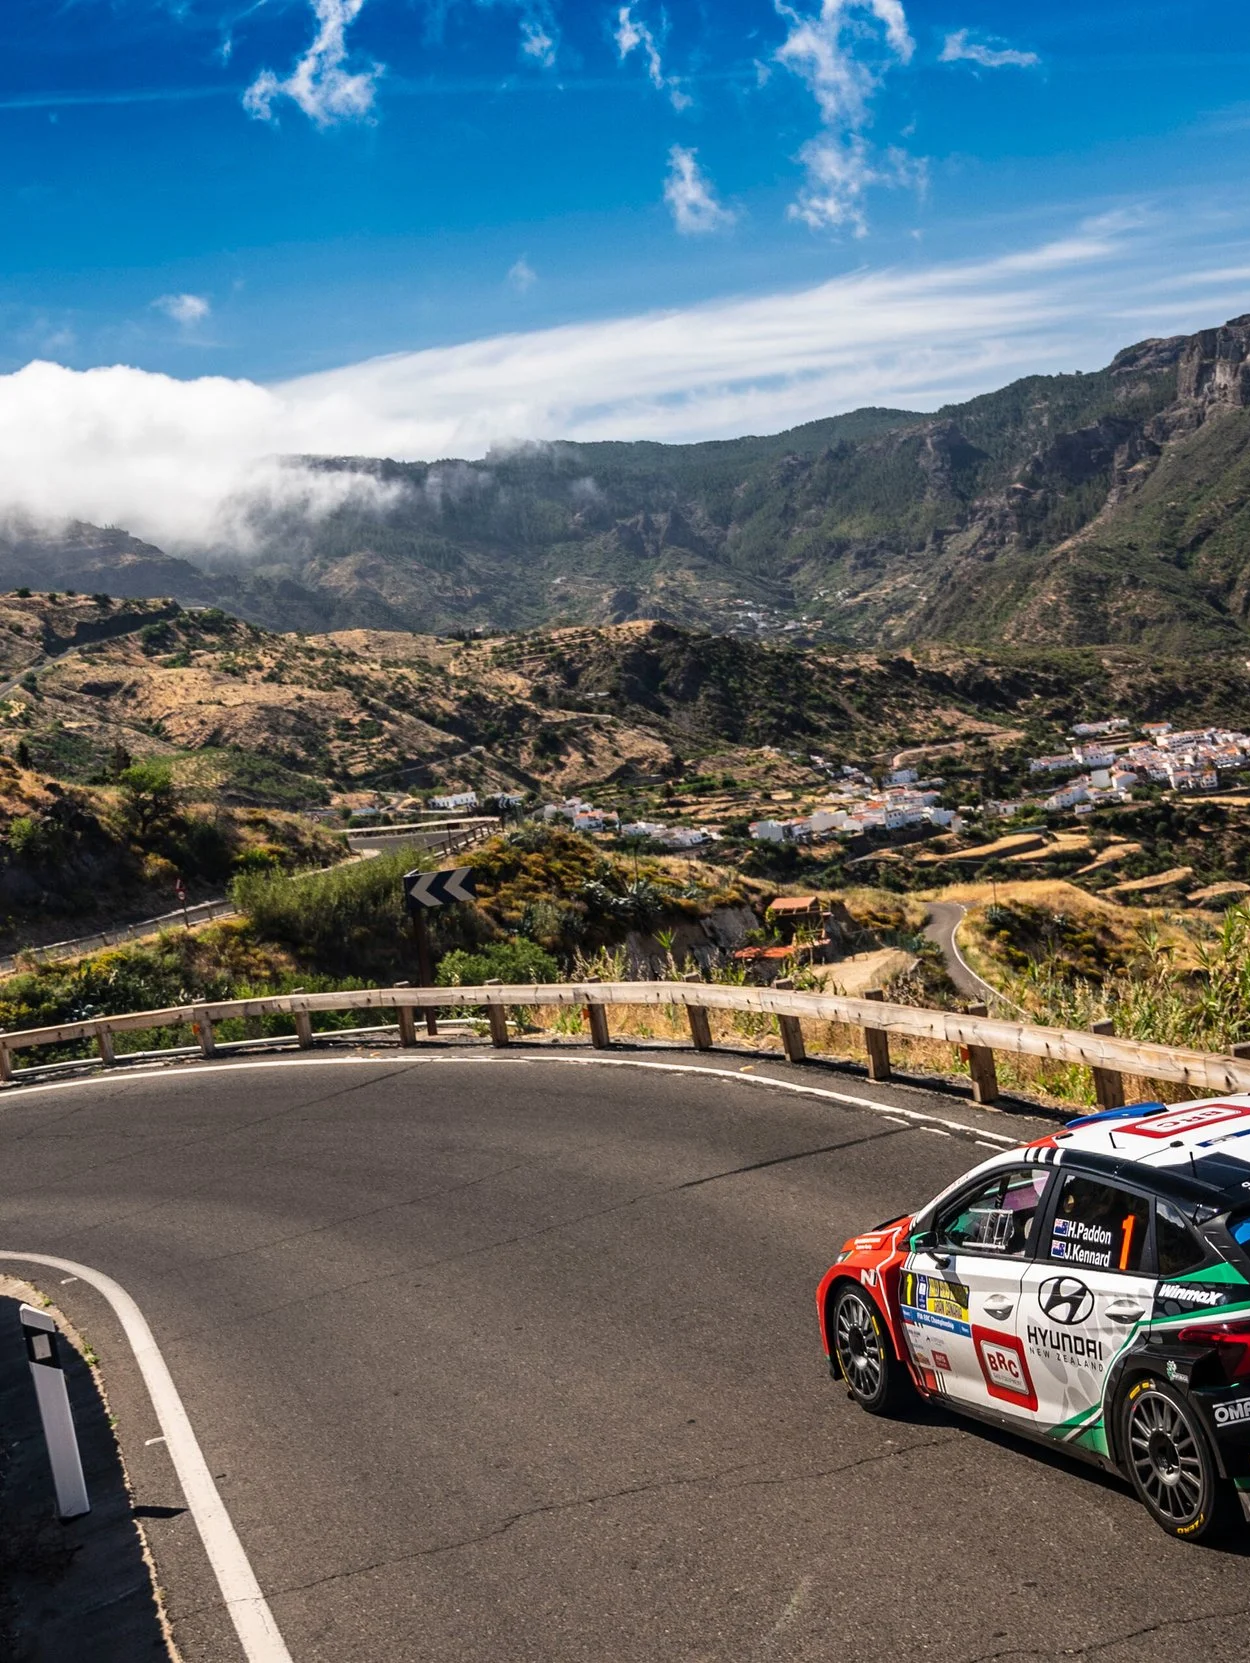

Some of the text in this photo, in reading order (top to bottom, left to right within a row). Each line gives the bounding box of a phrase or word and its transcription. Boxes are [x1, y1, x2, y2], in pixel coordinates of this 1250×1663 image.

[1156, 1109, 1225, 1128] BRC
[1068, 1221, 1112, 1245] H.Paddon
[1120, 1215, 1135, 1270] 1
[1064, 1243, 1112, 1267] J.Kennard
[906, 1273, 913, 1306] 1
[1027, 1325, 1103, 1361] HYUNDAI
[987, 1351, 1019, 1378] BRC
[1029, 1347, 1104, 1372] NEW ZEALAND
